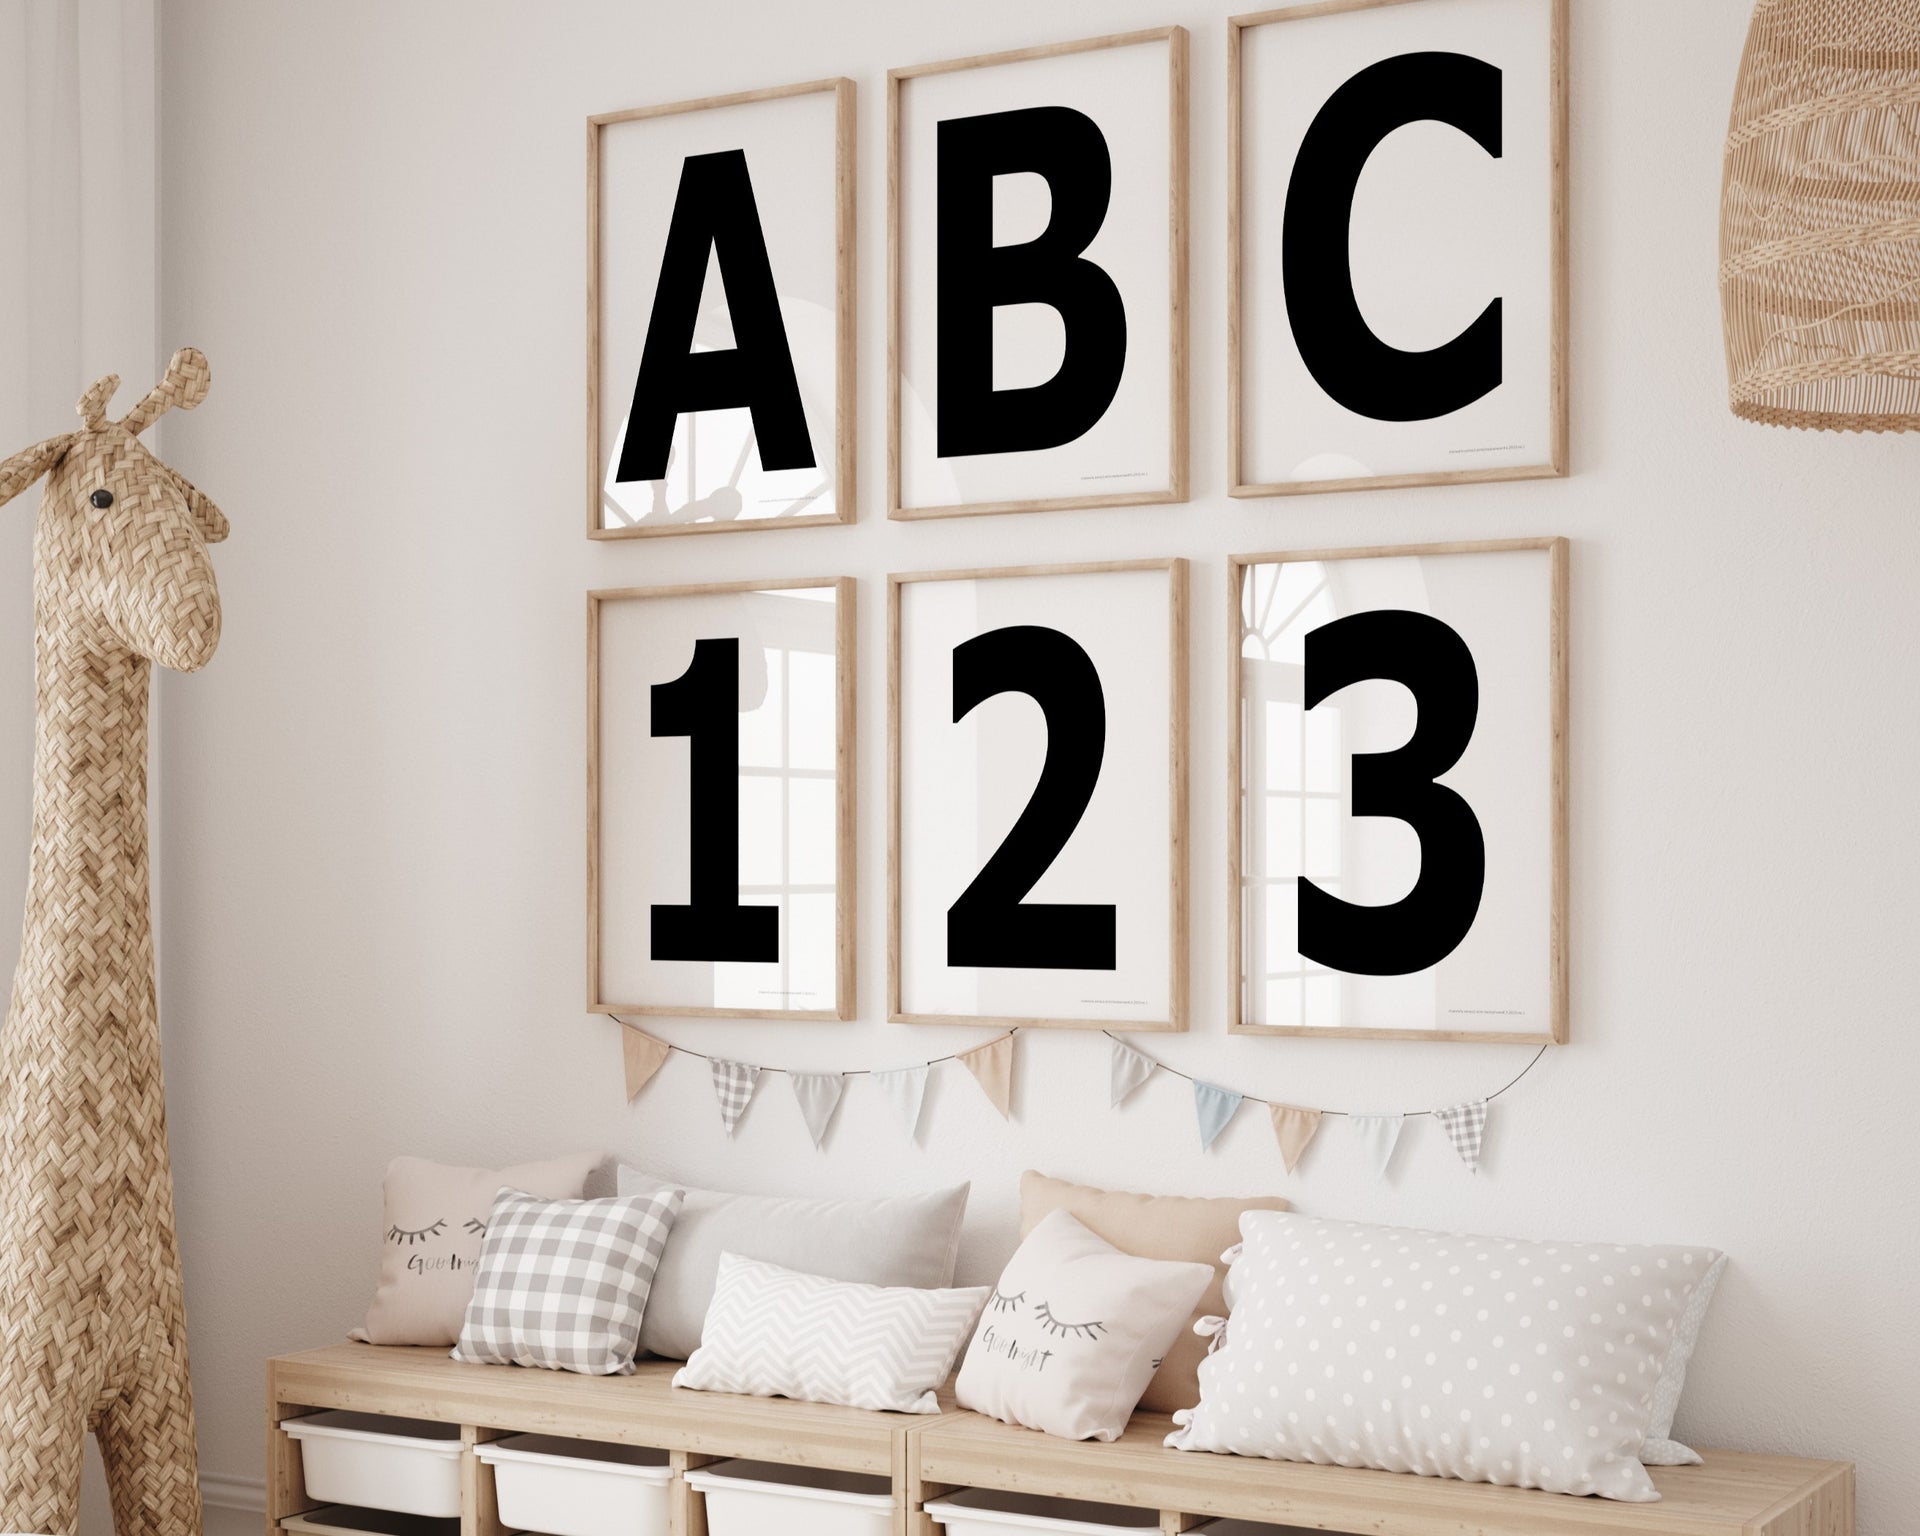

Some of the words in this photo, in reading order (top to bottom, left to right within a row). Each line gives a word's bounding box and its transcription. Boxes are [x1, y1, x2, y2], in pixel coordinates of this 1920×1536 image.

[616, 149, 816, 482] A
[938, 107, 1126, 458] B
[1283, 52, 1502, 421] C
[651, 638, 778, 962] 1
[948, 626, 1116, 970] 2
[1298, 610, 1485, 975] 3
